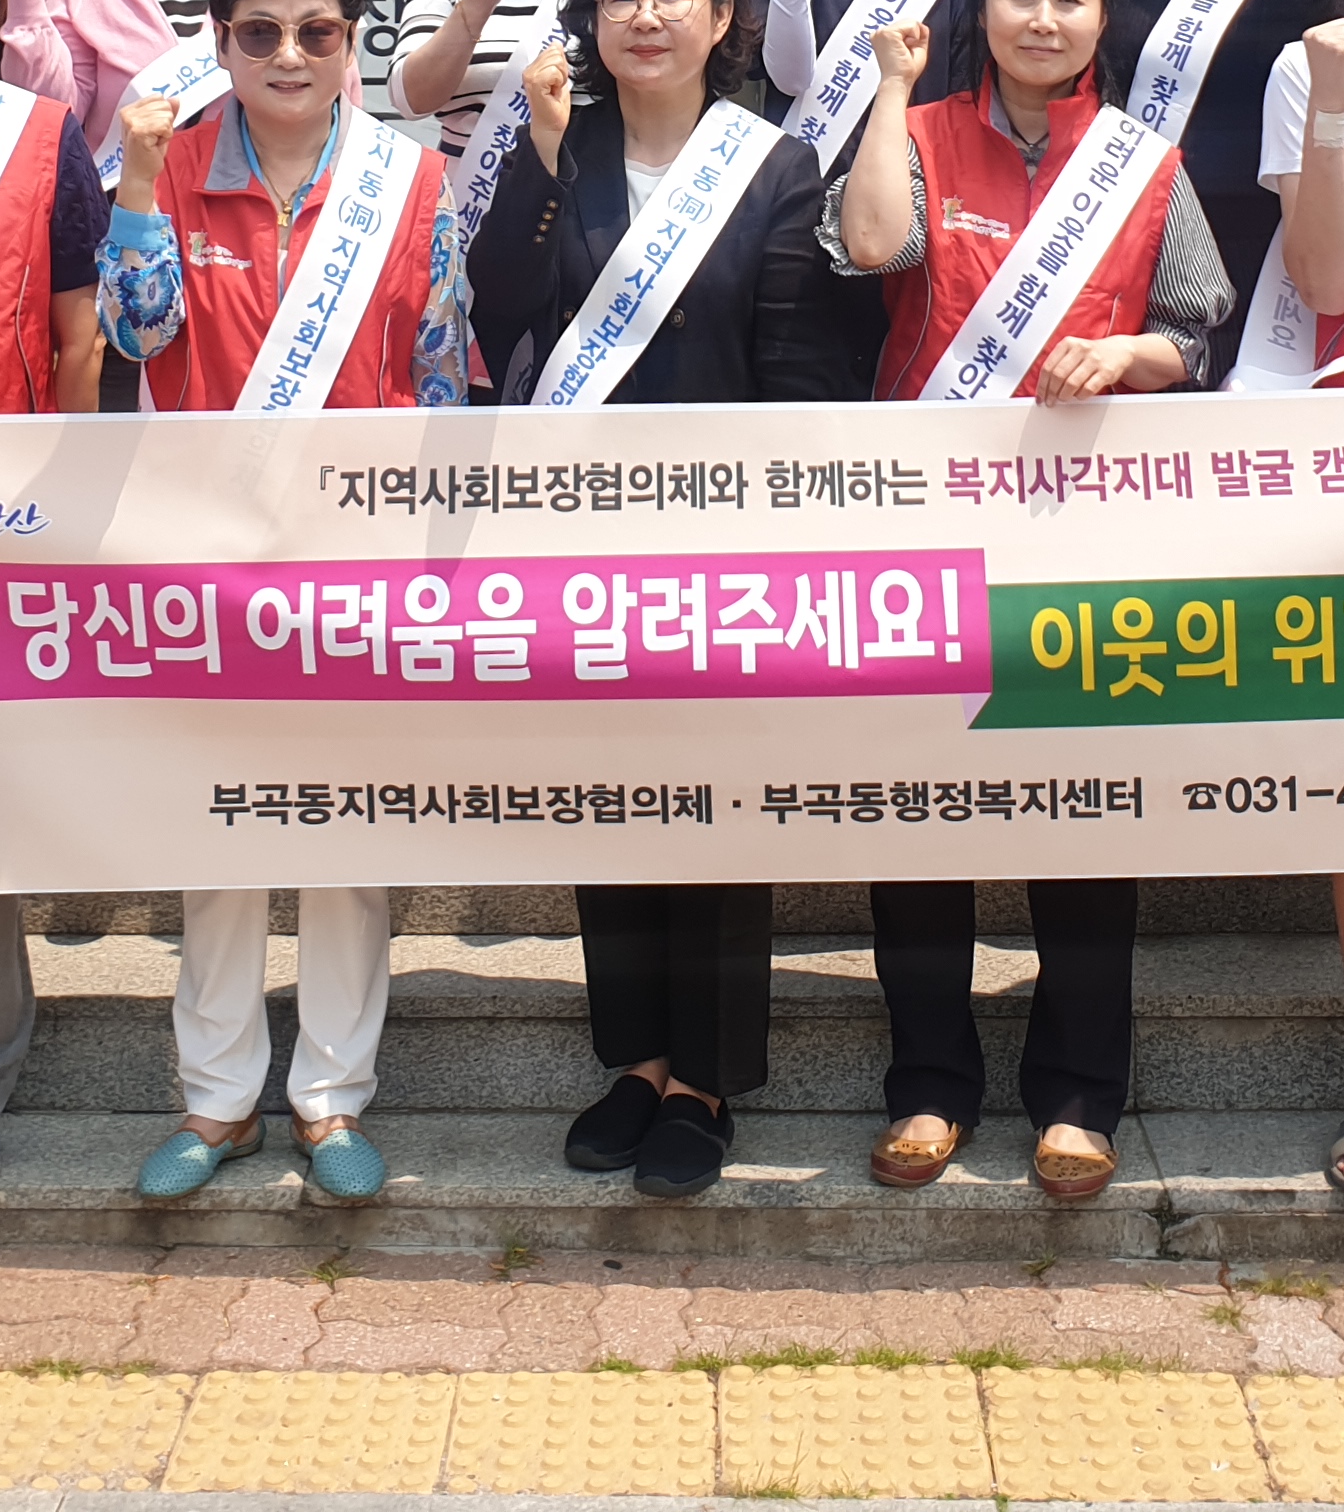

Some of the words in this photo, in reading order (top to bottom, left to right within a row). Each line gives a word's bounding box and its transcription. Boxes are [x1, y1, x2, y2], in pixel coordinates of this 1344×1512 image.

[1160, 16, 1203, 73] 함께
[817, 60, 861, 118] 함께
[1088, 119, 1146, 193] 어려운
[1035, 191, 1103, 277] 이웃을
[995, 272, 1049, 340] 함께
[319, 460, 750, 517] 『지역사회보장협의체와
[764, 459, 928, 509] 함께하는
[943, 450, 1194, 506] 복지사각지대
[1210, 449, 1296, 499] 발굴
[4, 579, 221, 682] 당신의
[246, 571, 538, 683] 어려움을
[561, 566, 963, 681] 알려주세요!
[1029, 593, 1238, 698] 이웃의
[208, 782, 714, 826] 부곡동지역사회보장협의체
[759, 776, 1144, 825] 부곡동행정복지센터
